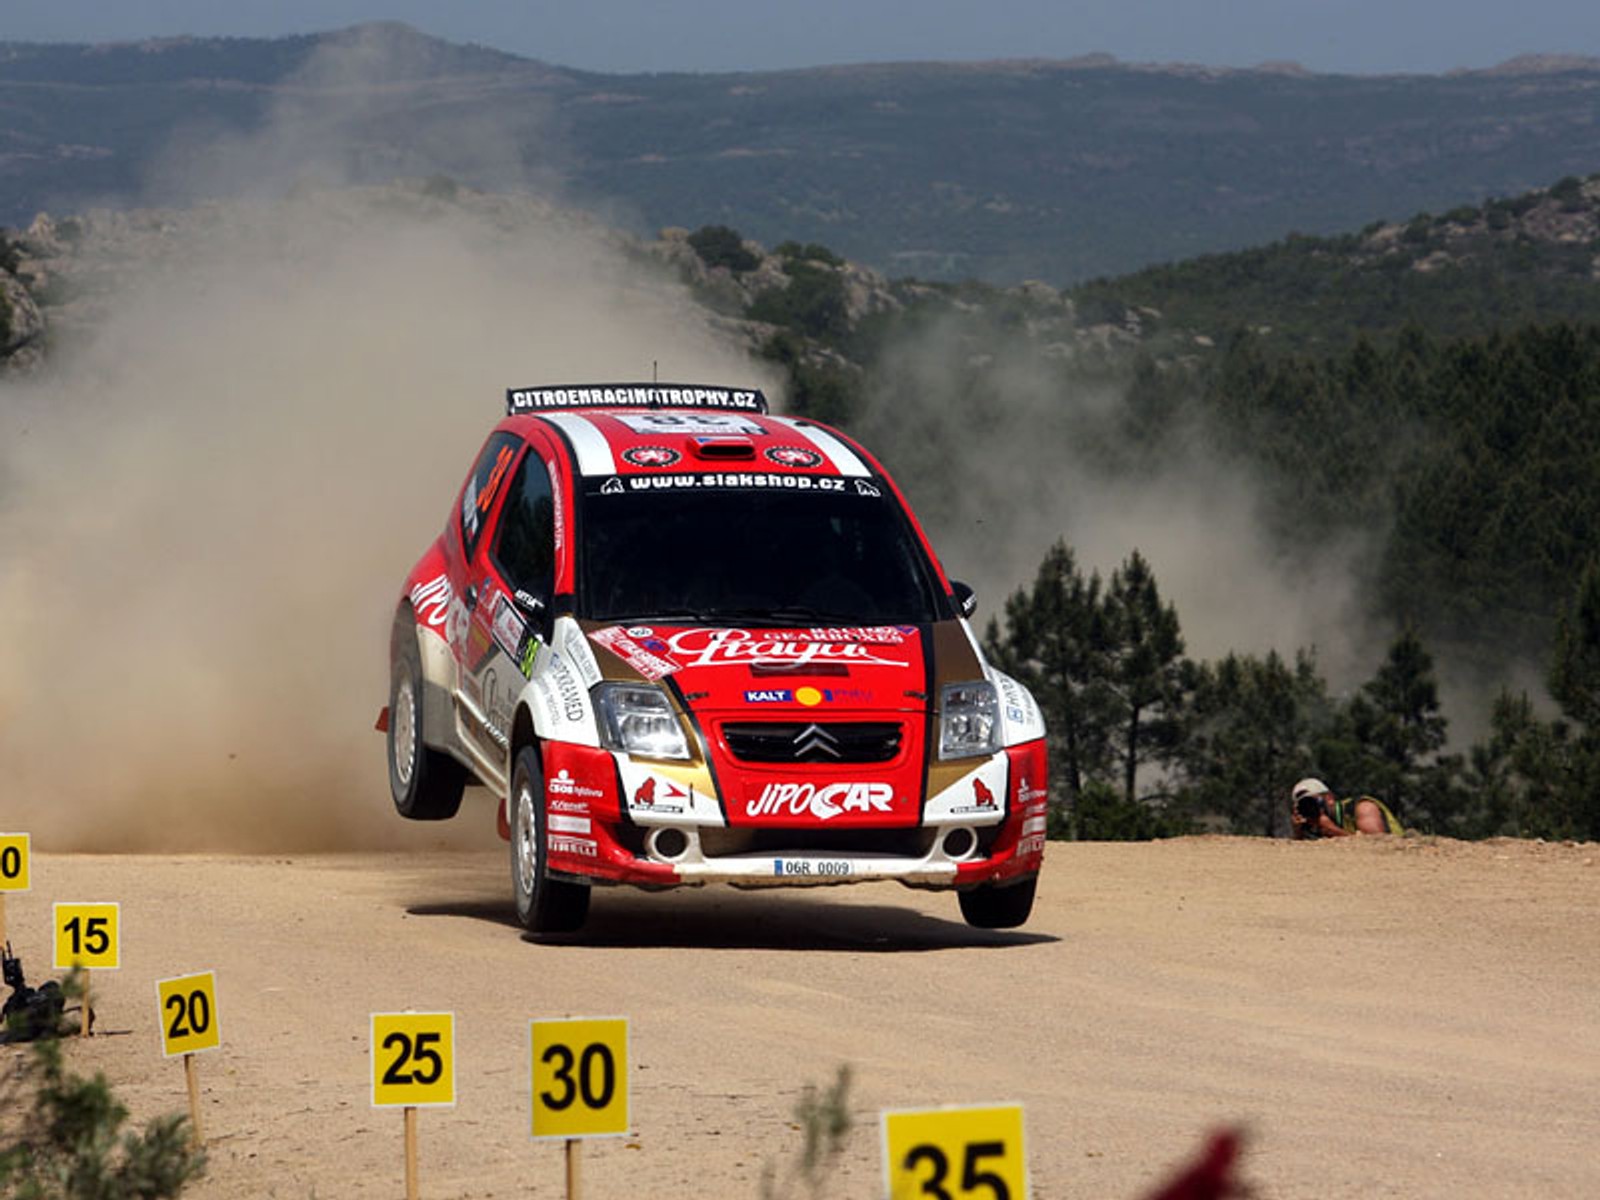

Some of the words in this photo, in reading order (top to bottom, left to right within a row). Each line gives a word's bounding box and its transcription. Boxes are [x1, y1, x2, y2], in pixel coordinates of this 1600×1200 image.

[630, 474, 845, 491] www.slakshop.cz
[747, 691, 786, 702] KALT
[0, 846, 21, 879] 0
[63, 915, 110, 955] 15
[165, 990, 210, 1039] 20
[381, 1032, 443, 1085] 25
[540, 1042, 616, 1112] 30
[903, 1140, 1012, 1200] 35
